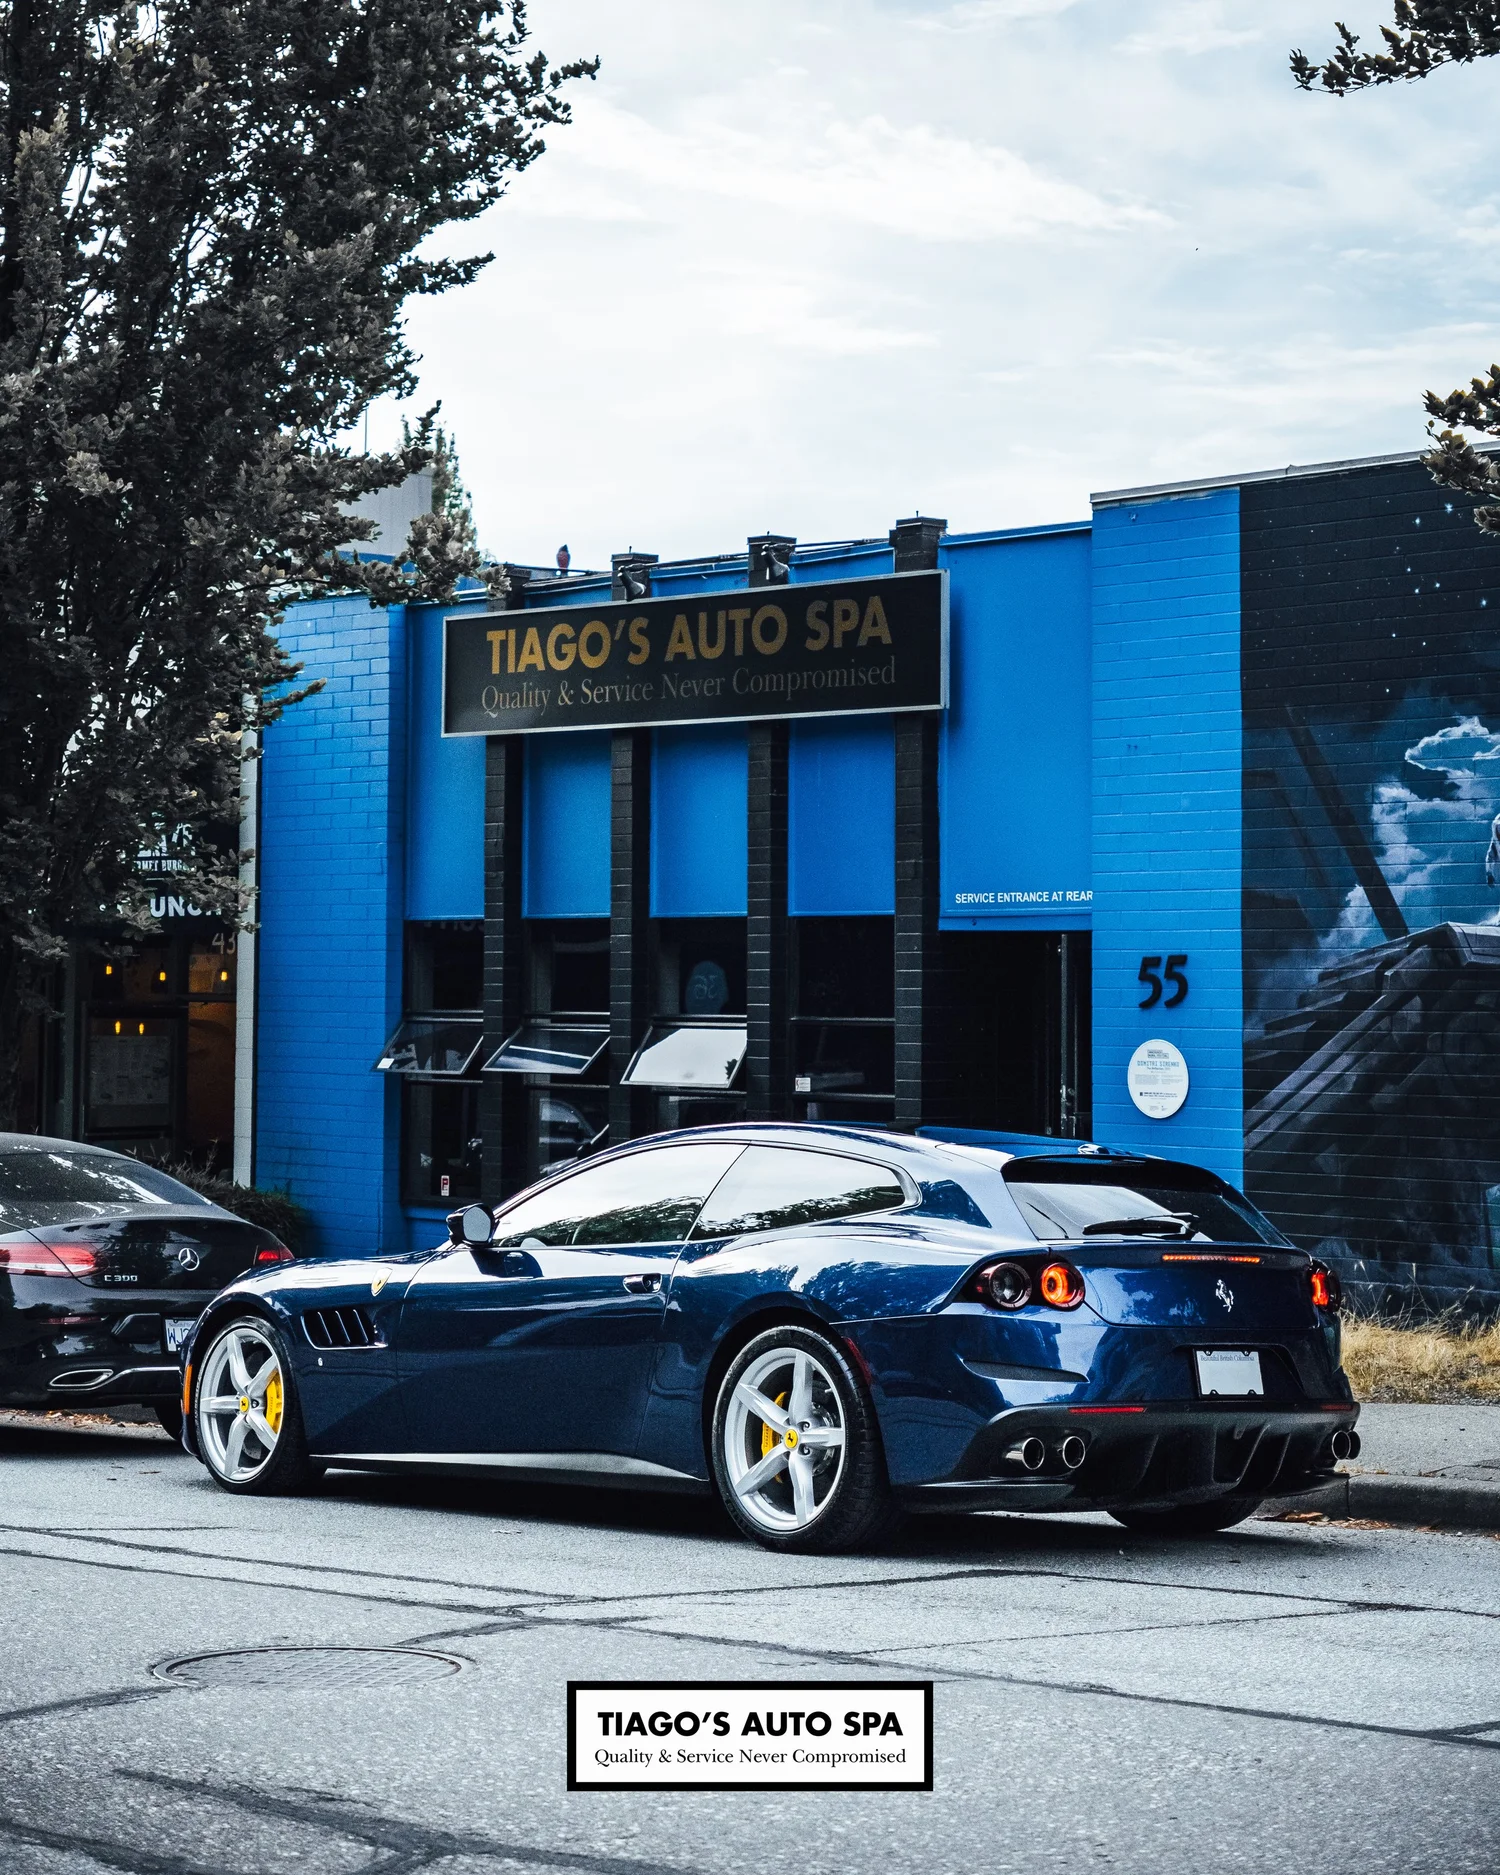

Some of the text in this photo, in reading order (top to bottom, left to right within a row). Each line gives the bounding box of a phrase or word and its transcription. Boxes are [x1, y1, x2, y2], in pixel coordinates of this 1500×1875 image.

[486, 595, 893, 674] TIAGO'S AUTO SPA
[481, 655, 897, 718] Quality & Service Never Compromised
[955, 890, 1094, 904] SERVICE ENTRANCE AT REAR
[1138, 954, 1188, 1009] 55
[104, 1274, 138, 1282] C 300
[167, 1327, 191, 1345] WJ
